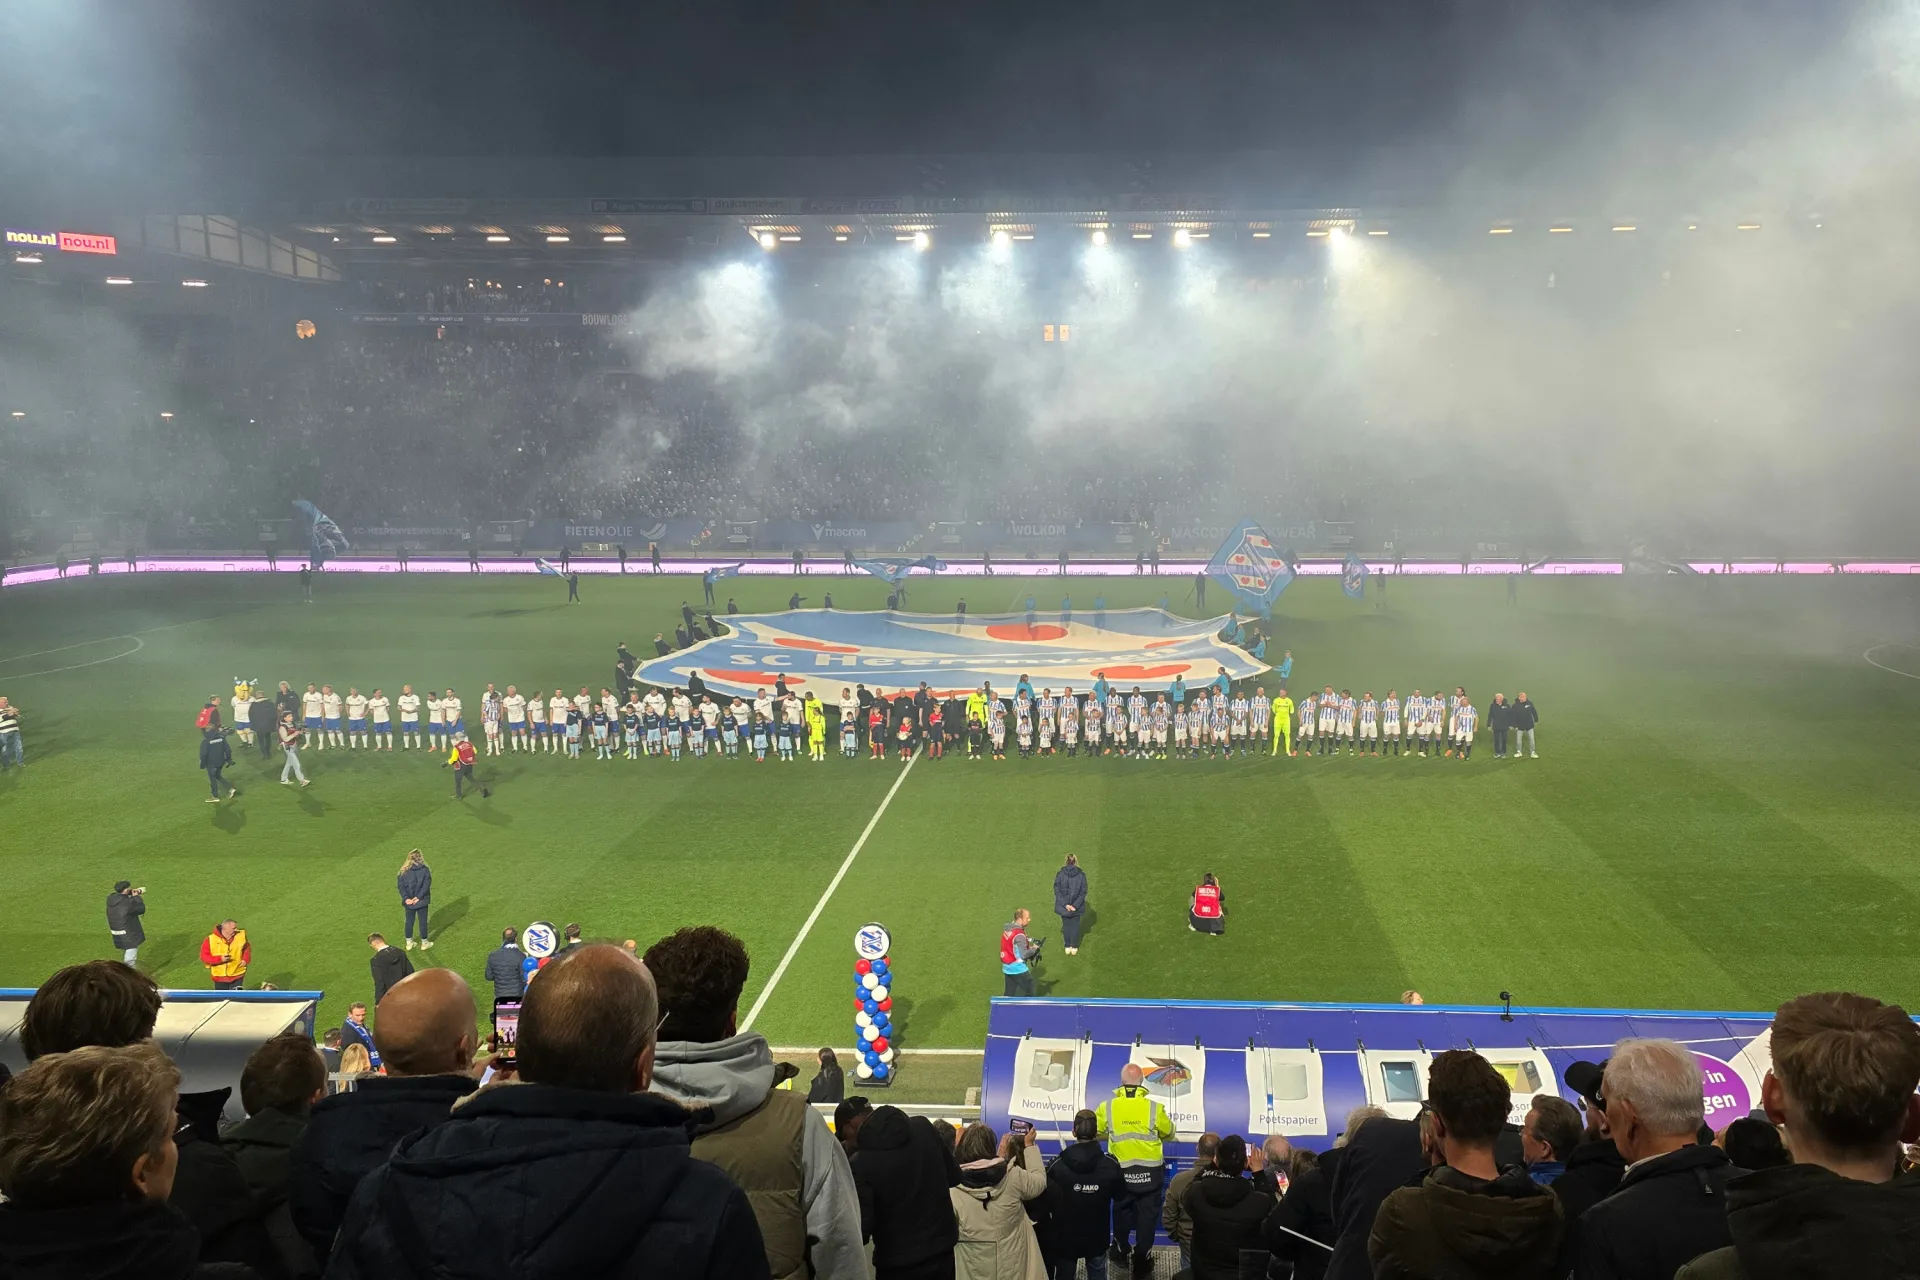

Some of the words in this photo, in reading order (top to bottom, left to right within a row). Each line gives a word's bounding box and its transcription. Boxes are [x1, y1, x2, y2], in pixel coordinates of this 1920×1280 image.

[6, 231, 57, 245] nou.nl
[64, 236, 109, 250] nou.nl
[497, 525, 508, 533] 17
[565, 526, 604, 537] FIETEN
[606, 526, 633, 537] OLIE
[733, 526, 743, 534] 18
[825, 528, 867, 538] macron
[1012, 525, 1067, 536] WOLKOM
[1171, 527, 1226, 539] MASCOT
[1705, 1069, 1727, 1084] in
[1022, 1098, 1074, 1112] Nonwoven
[1702, 1093, 1737, 1115] gen
[1167, 1112, 1198, 1123] appen
[1259, 1114, 1319, 1126] Poetspapier
